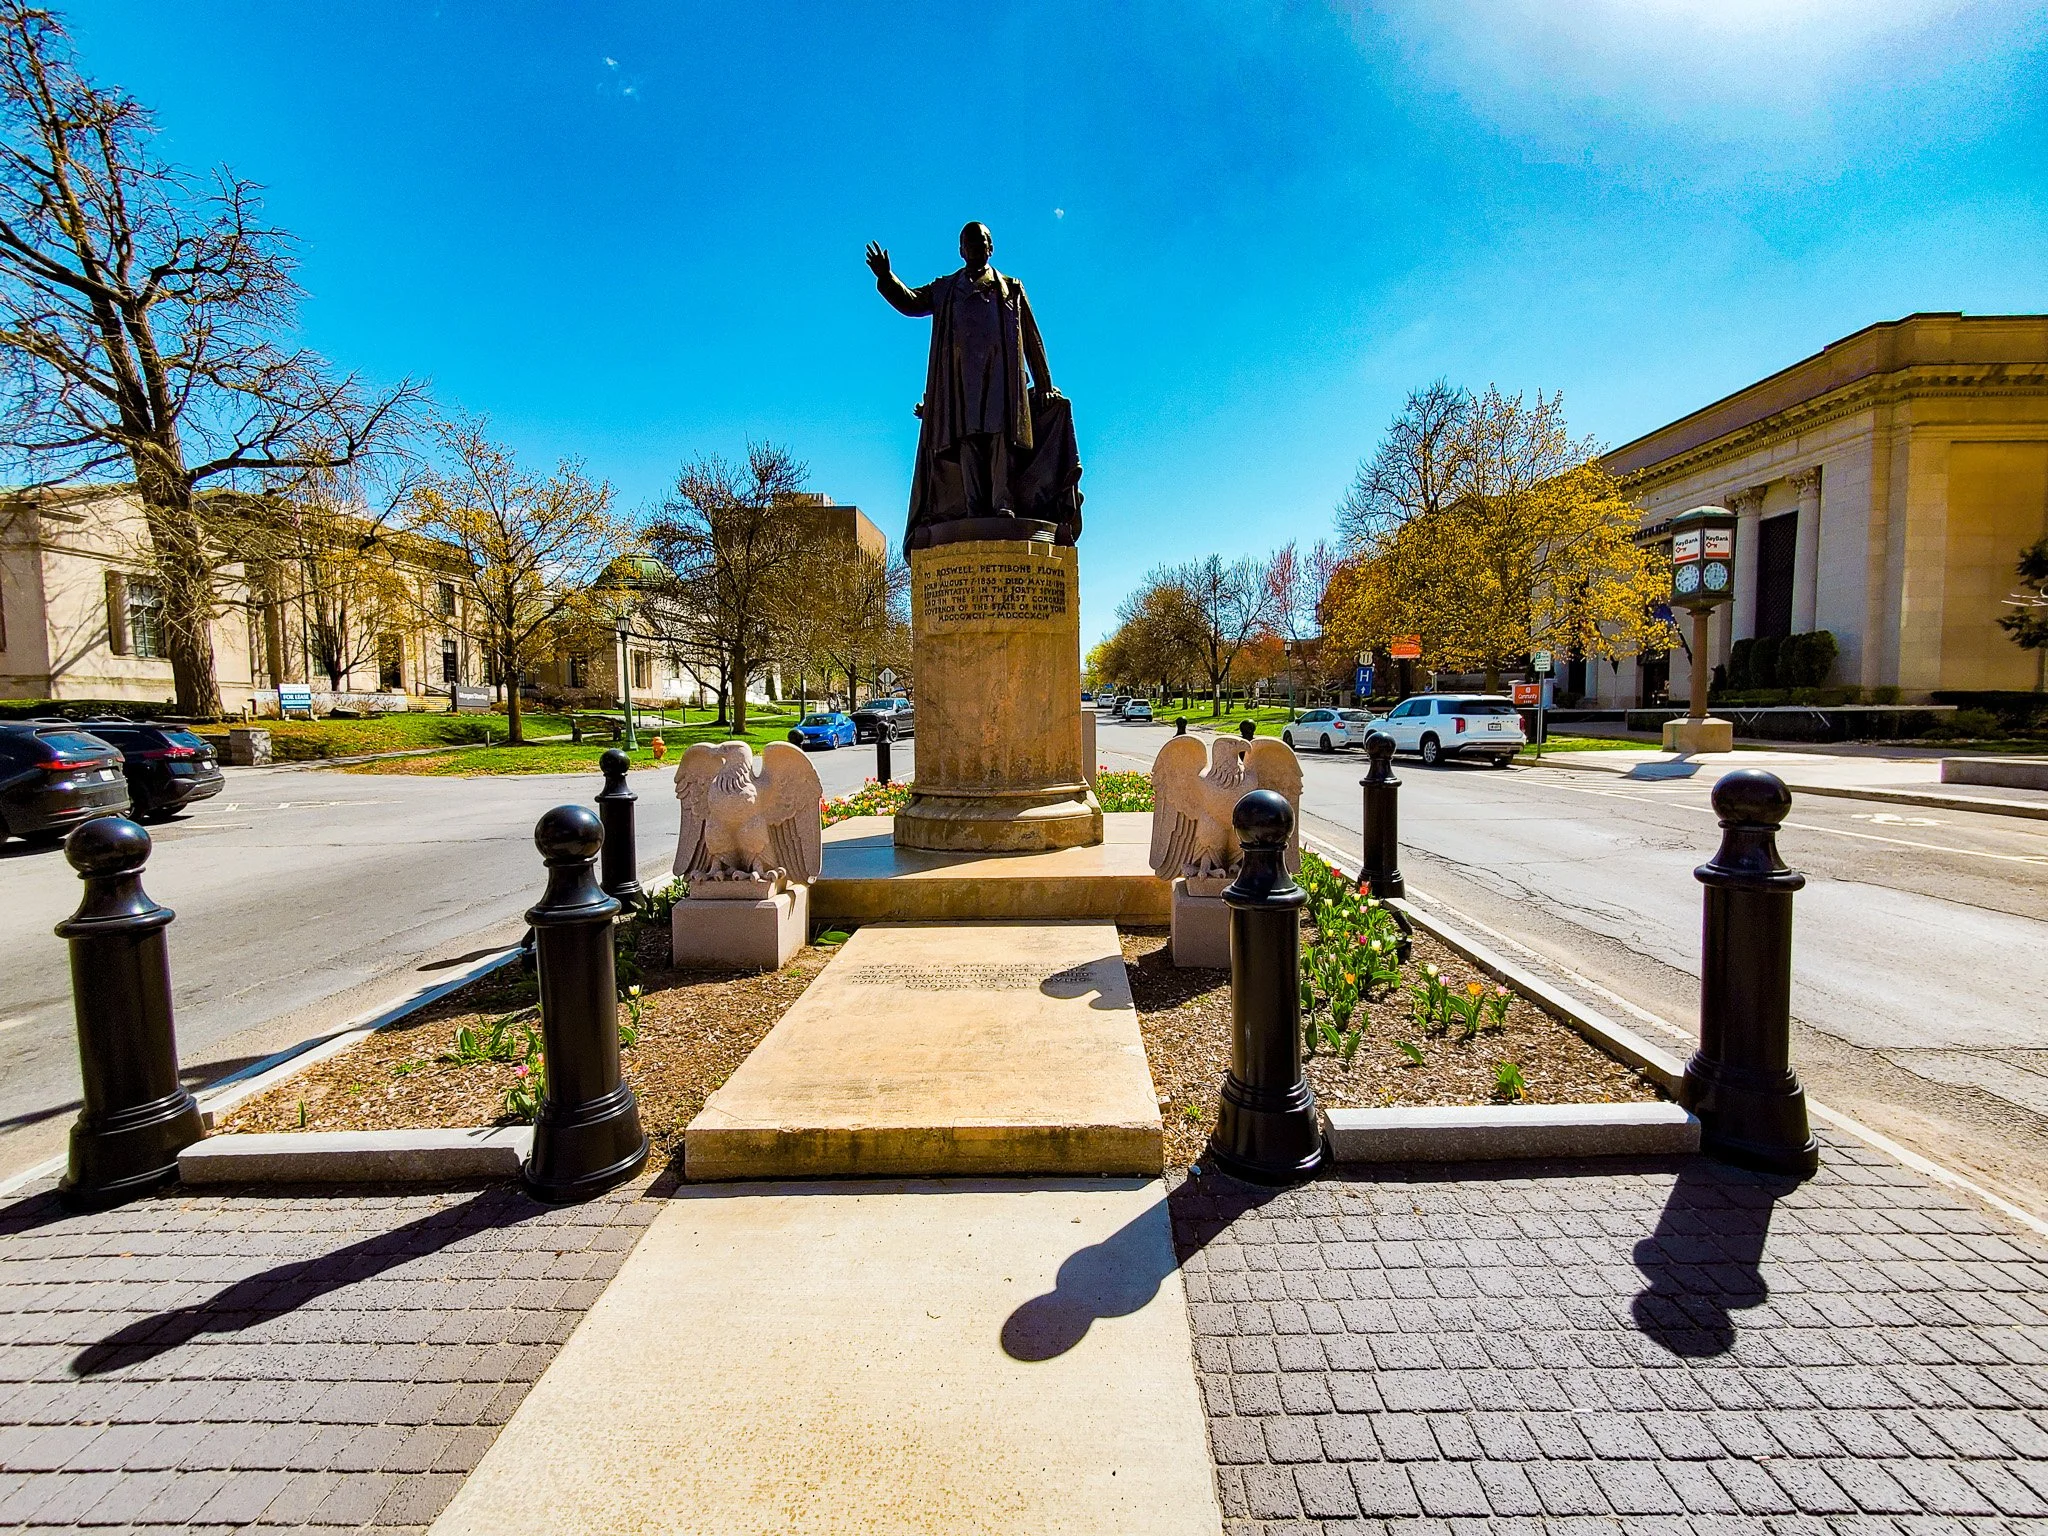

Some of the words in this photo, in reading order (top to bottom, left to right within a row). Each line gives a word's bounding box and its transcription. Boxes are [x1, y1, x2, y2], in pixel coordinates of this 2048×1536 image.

[1675, 538, 1698, 547] KeyBank
[936, 565, 974, 577] ROSWELL
[980, 564, 1031, 573] PETTIBONE
[1037, 566, 1065, 577] FLOWER
[924, 582, 938, 591] BORN
[940, 578, 969, 588] AUGUST
[1005, 577, 1024, 585] DIED
[1027, 578, 1045, 587] MAY
[924, 586, 975, 599] REPRESENTATIVE
[1011, 586, 1037, 594] FORTY
[924, 599, 936, 607] AND
[1002, 594, 1026, 602] FIRST
[924, 605, 956, 617] GOVERNOR
[973, 603, 989, 611] THE
[991, 602, 1017, 611] STATE
[1019, 603, 1029, 611] OF
[1050, 604, 1067, 613] YORK
[1359, 670, 1370, 682] H
